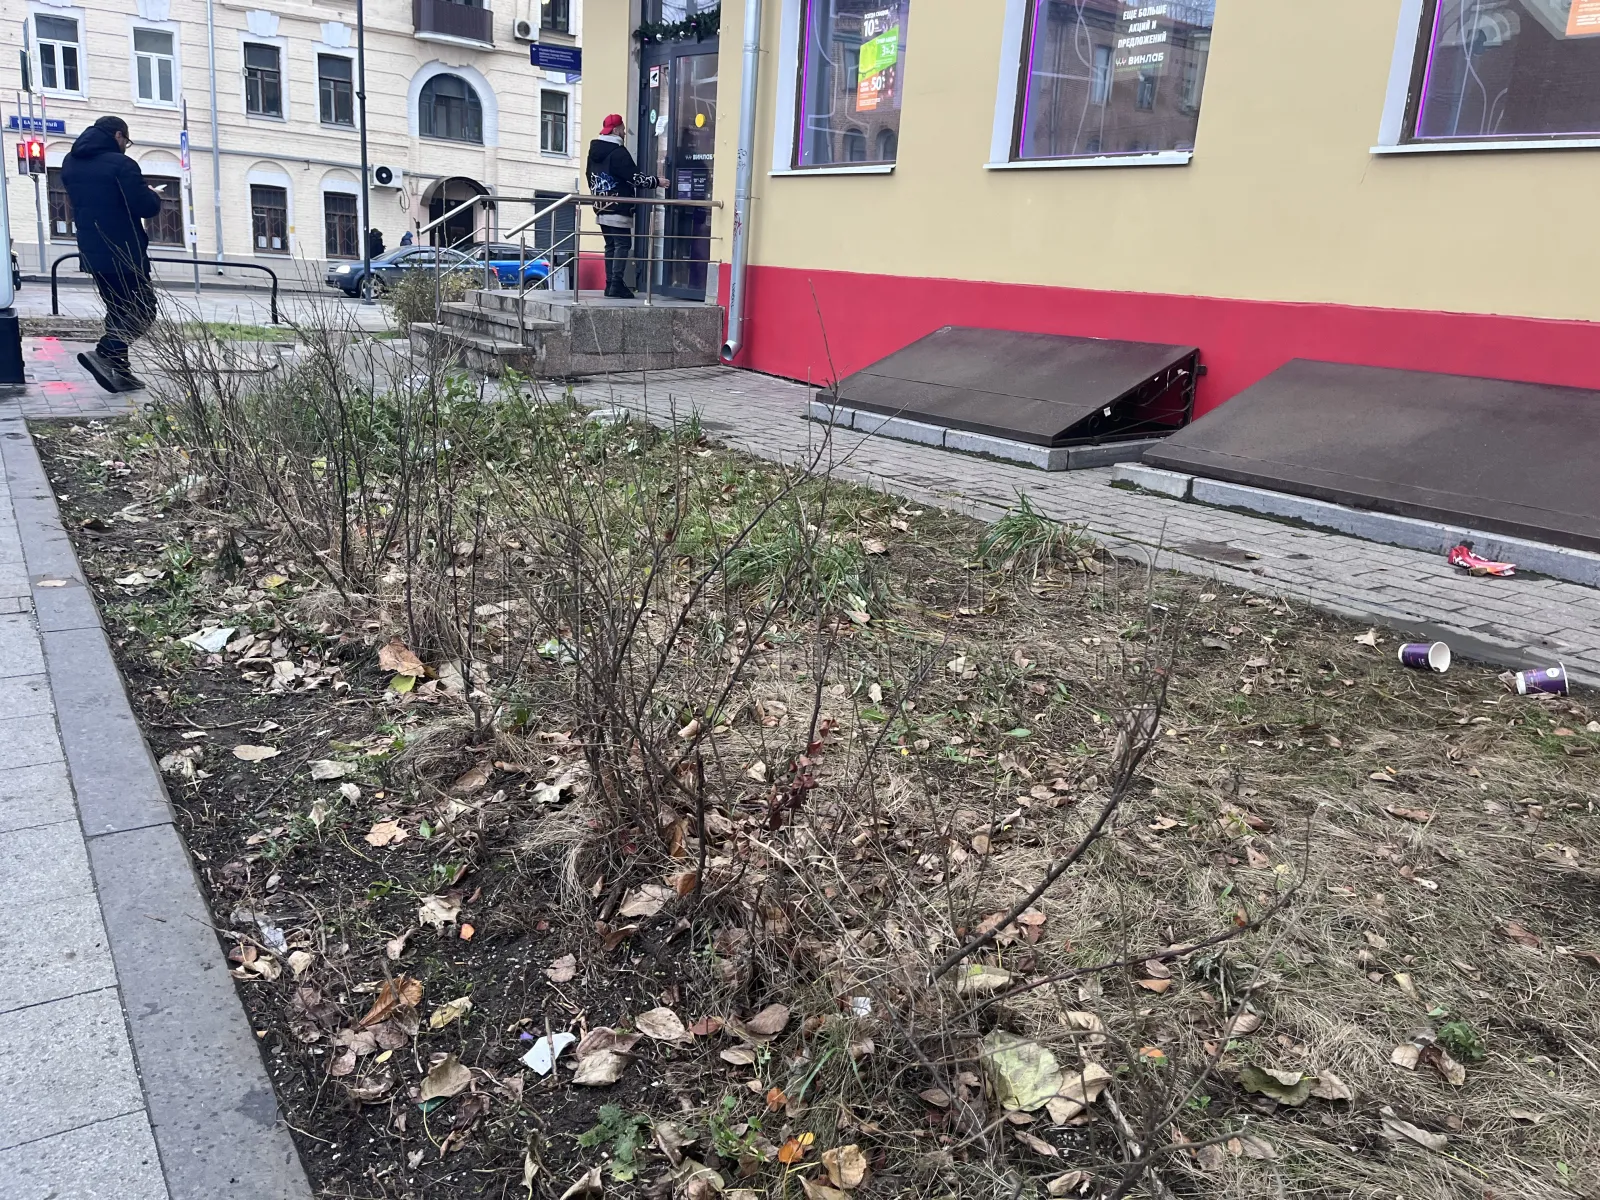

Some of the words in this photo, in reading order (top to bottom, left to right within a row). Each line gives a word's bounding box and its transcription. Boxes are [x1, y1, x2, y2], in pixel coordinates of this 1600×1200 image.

[1122, 10, 1138, 20] ЕЩЕ
[1138, 4, 1168, 18] БОЛЬШЕ
[1128, 20, 1151, 33] АКЦИЙ
[1151, 20, 1157, 30] И
[1117, 30, 1167, 49] ПРЕДЛОЖЕНИЙ
